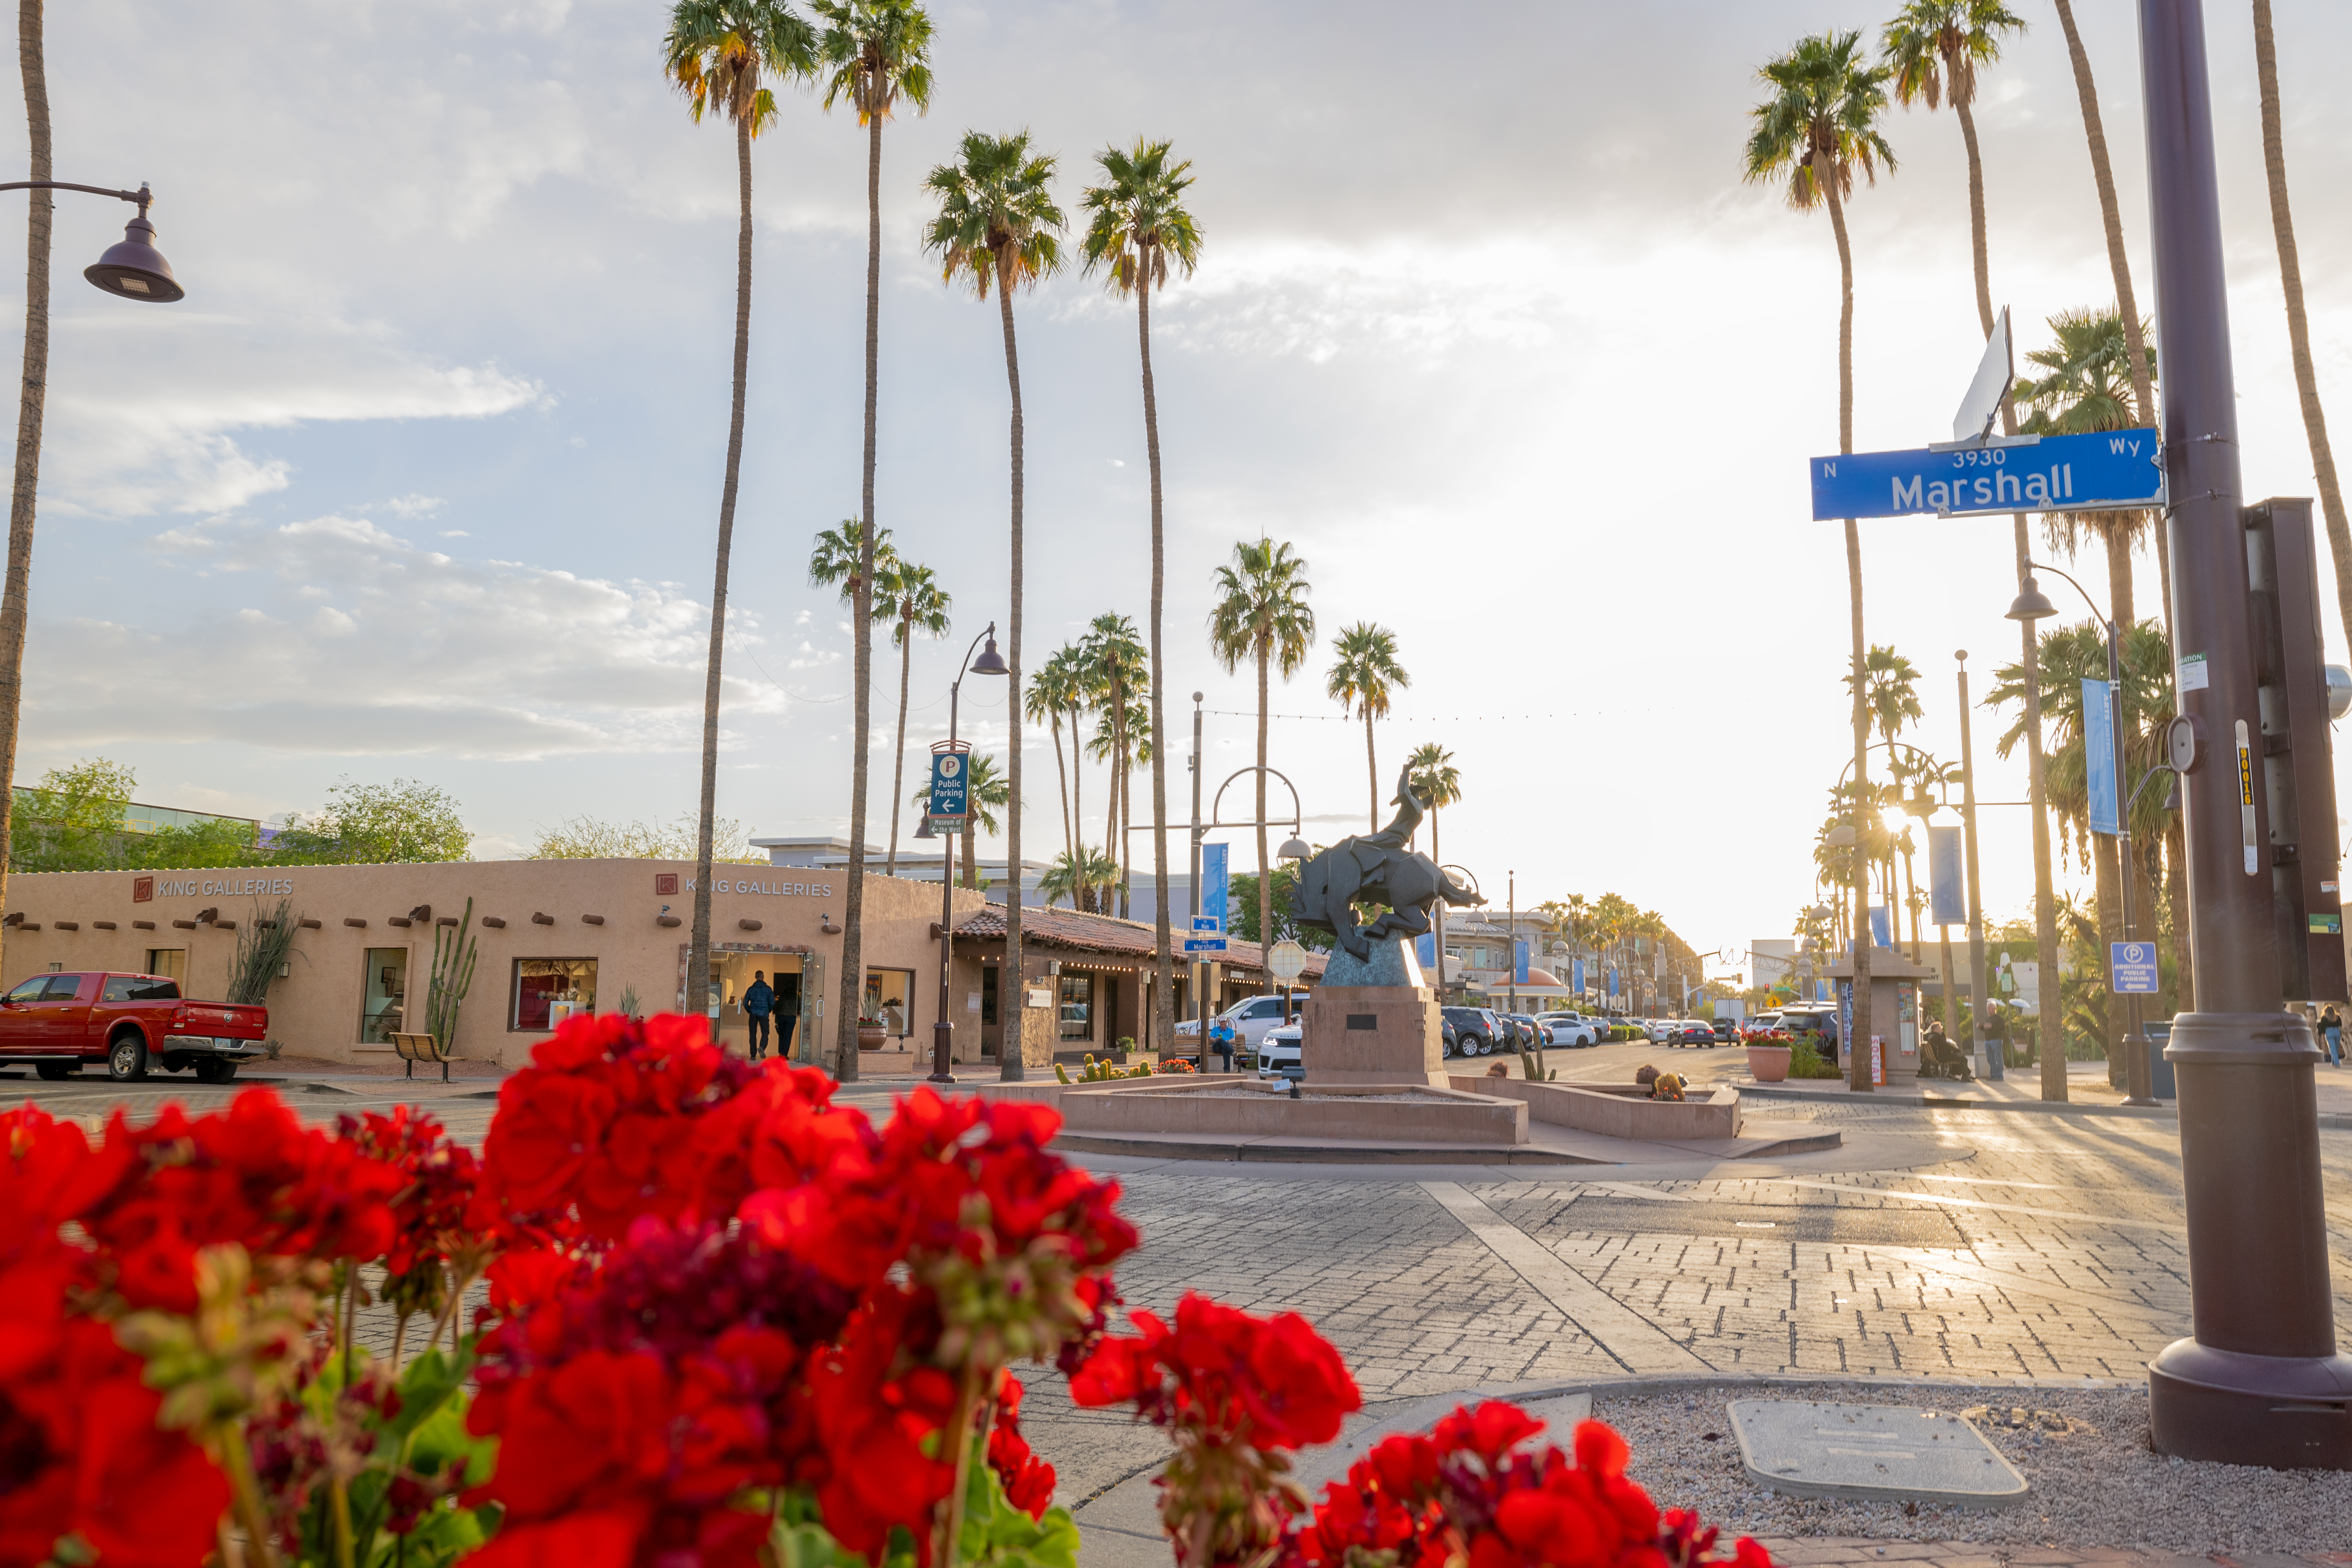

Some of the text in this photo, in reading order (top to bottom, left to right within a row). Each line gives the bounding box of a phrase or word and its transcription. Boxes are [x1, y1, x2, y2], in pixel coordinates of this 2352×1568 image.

[1824, 437, 2141, 478] N 3930 Wy
[1892, 463, 2073, 510] Marshall
[938, 779, 961, 788] Public
[2240, 748, 2251, 805] 90016
[935, 789, 963, 798] Parking
[158, 879, 293, 896] KING GALLERIES
[685, 878, 831, 897] KNG GALLERIES
[1084, 954, 1098, 964] 7077
[1871, 1039, 1880, 1081] SOCIAL
